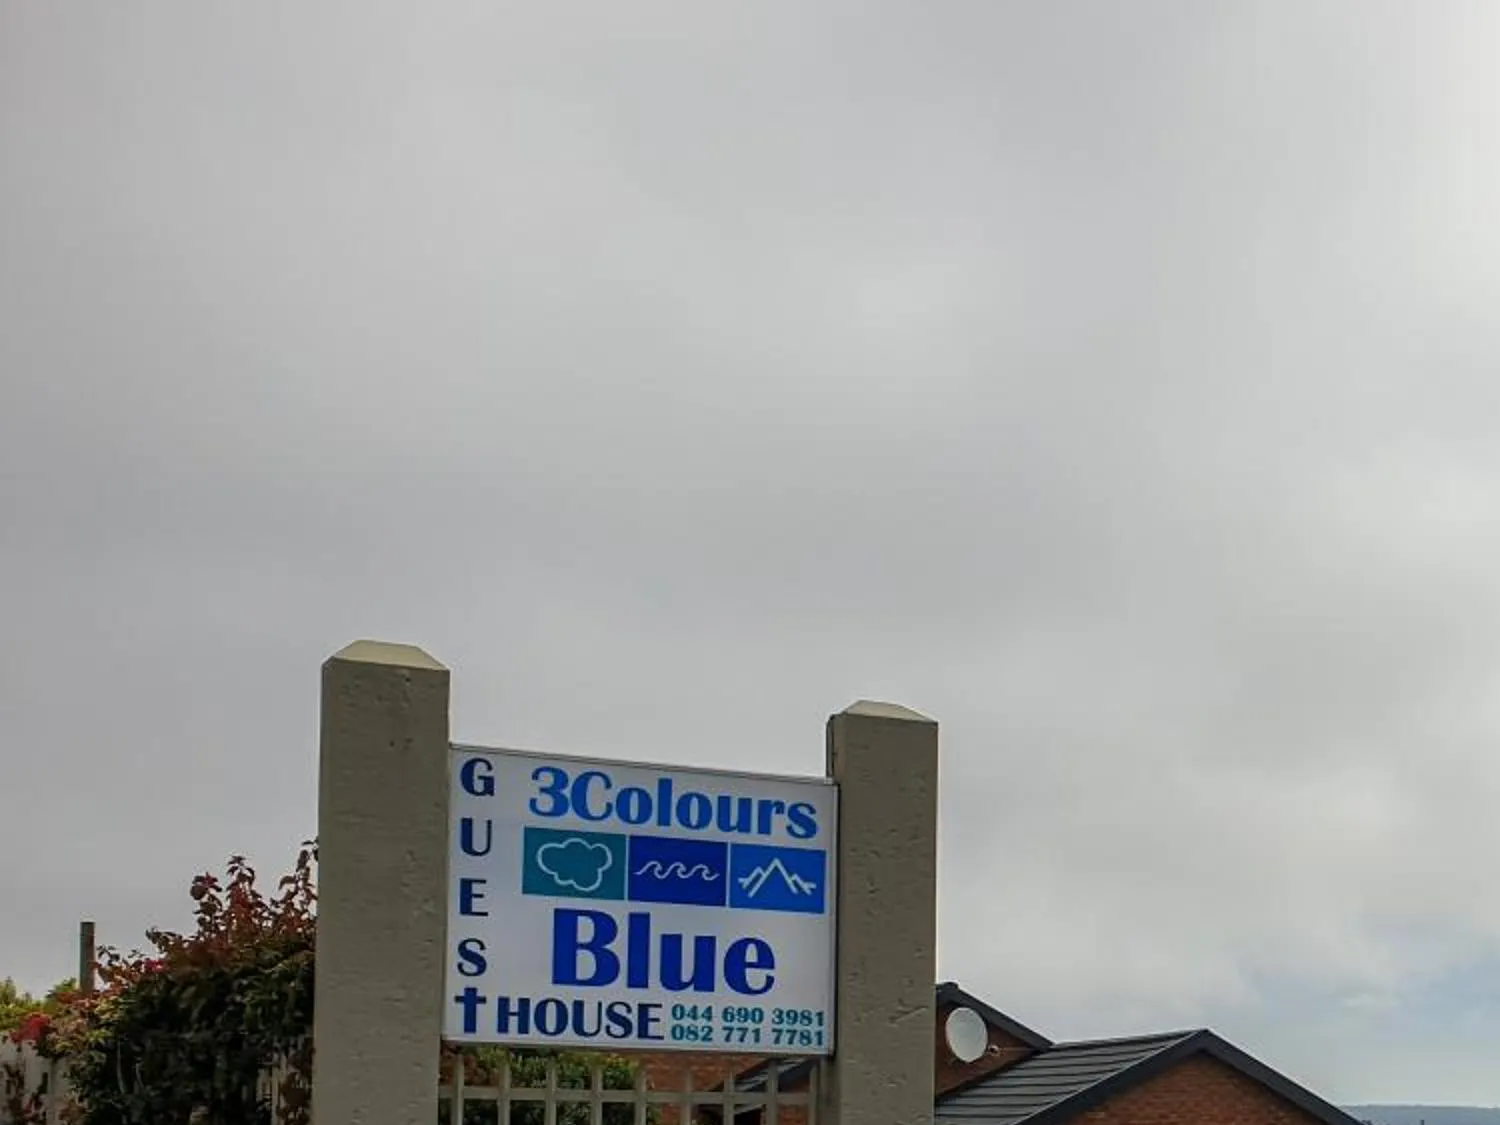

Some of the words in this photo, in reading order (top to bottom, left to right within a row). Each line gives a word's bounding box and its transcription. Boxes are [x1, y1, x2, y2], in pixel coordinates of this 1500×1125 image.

[529, 766, 818, 840] 3Colours
[551, 907, 776, 996] Blue
[496, 996, 665, 1041] HOUSE
[671, 1003, 713, 1023] 044
[721, 1006, 764, 1025] 690
[771, 1008, 825, 1027] 3981
[671, 1024, 713, 1042] 082
[723, 1026, 761, 1045] 771
[771, 1028, 825, 1046] 7781
